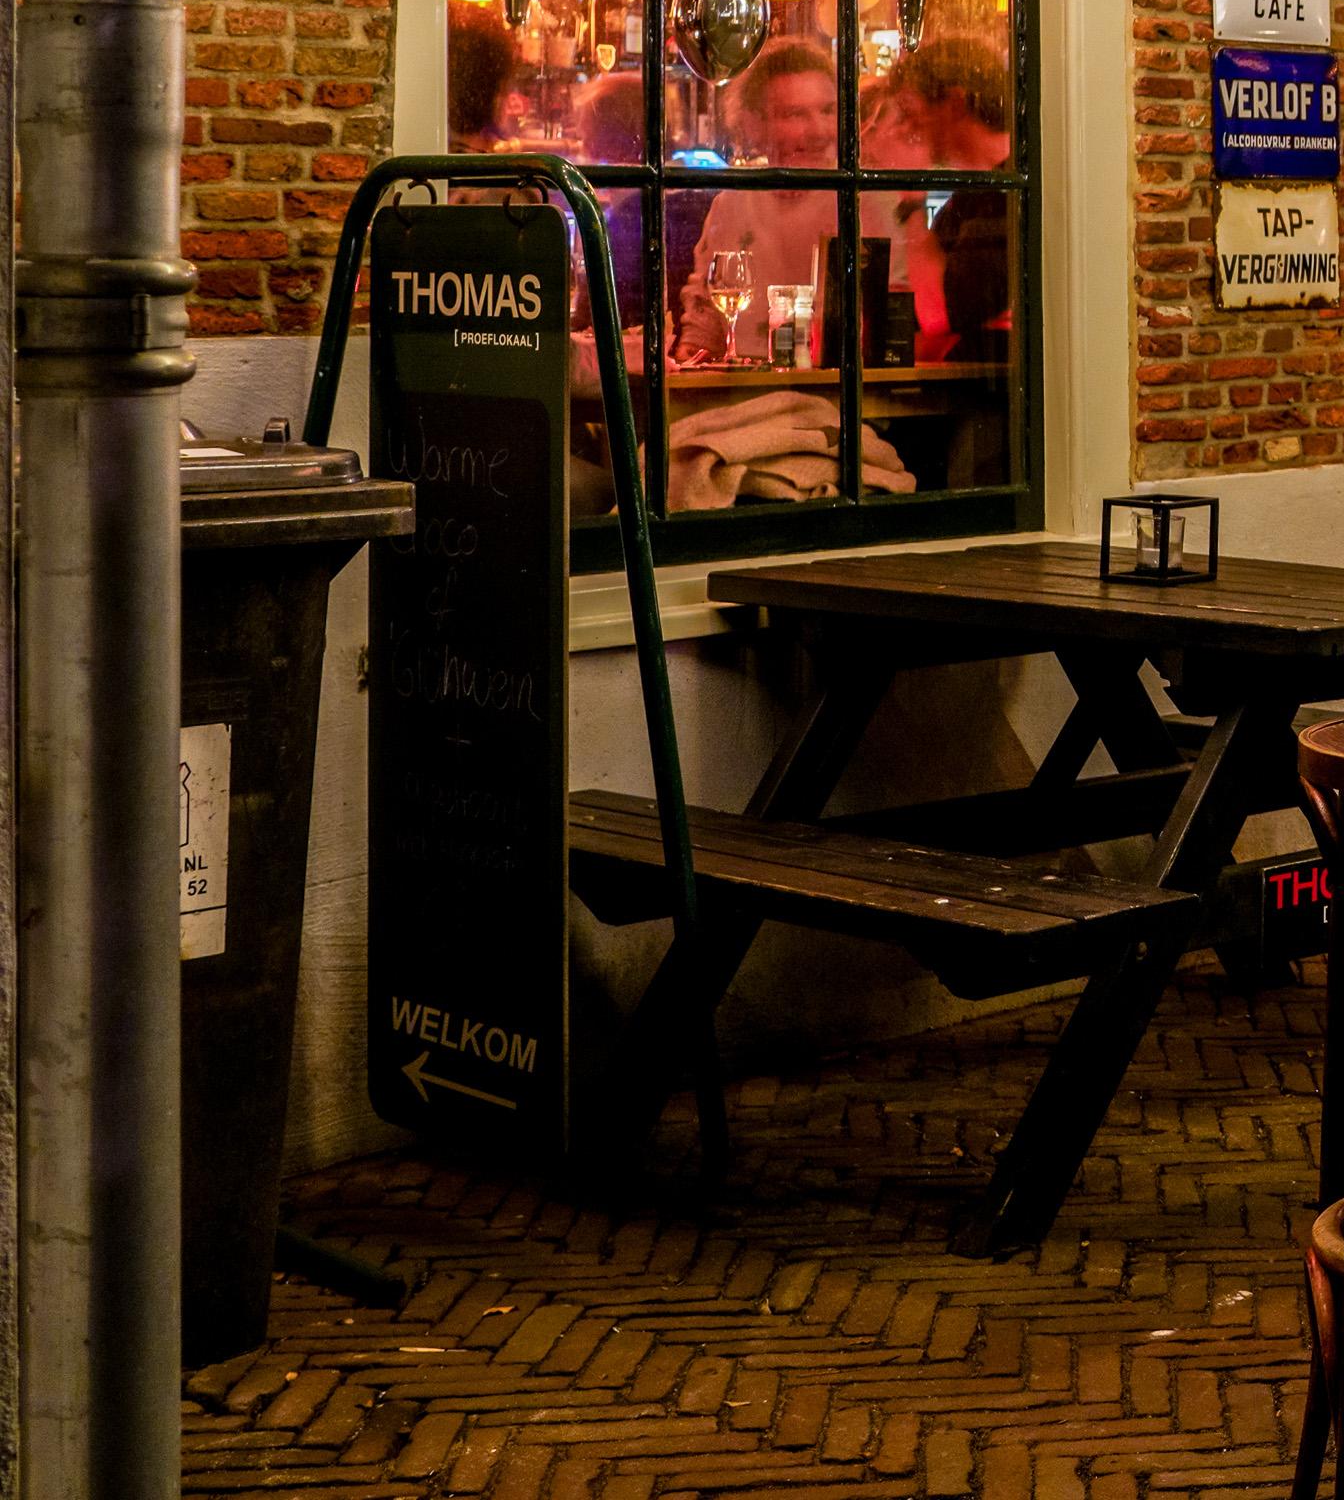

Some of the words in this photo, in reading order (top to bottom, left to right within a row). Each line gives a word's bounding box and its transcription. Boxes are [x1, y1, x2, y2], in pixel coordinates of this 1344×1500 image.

[1219, 78, 1315, 121] VERLOF
[1321, 84, 1337, 123] B
[1223, 131, 1291, 149] (ALCOHOLVRIJE
[1293, 136, 1337, 151] DRANKEN)
[1256, 207, 1314, 238] TAP-
[1221, 252, 1337, 285] VERGUNNING
[391, 271, 542, 320] THOMAS
[187, 879, 209, 897] 52
[391, 995, 537, 1073] WELKOM
